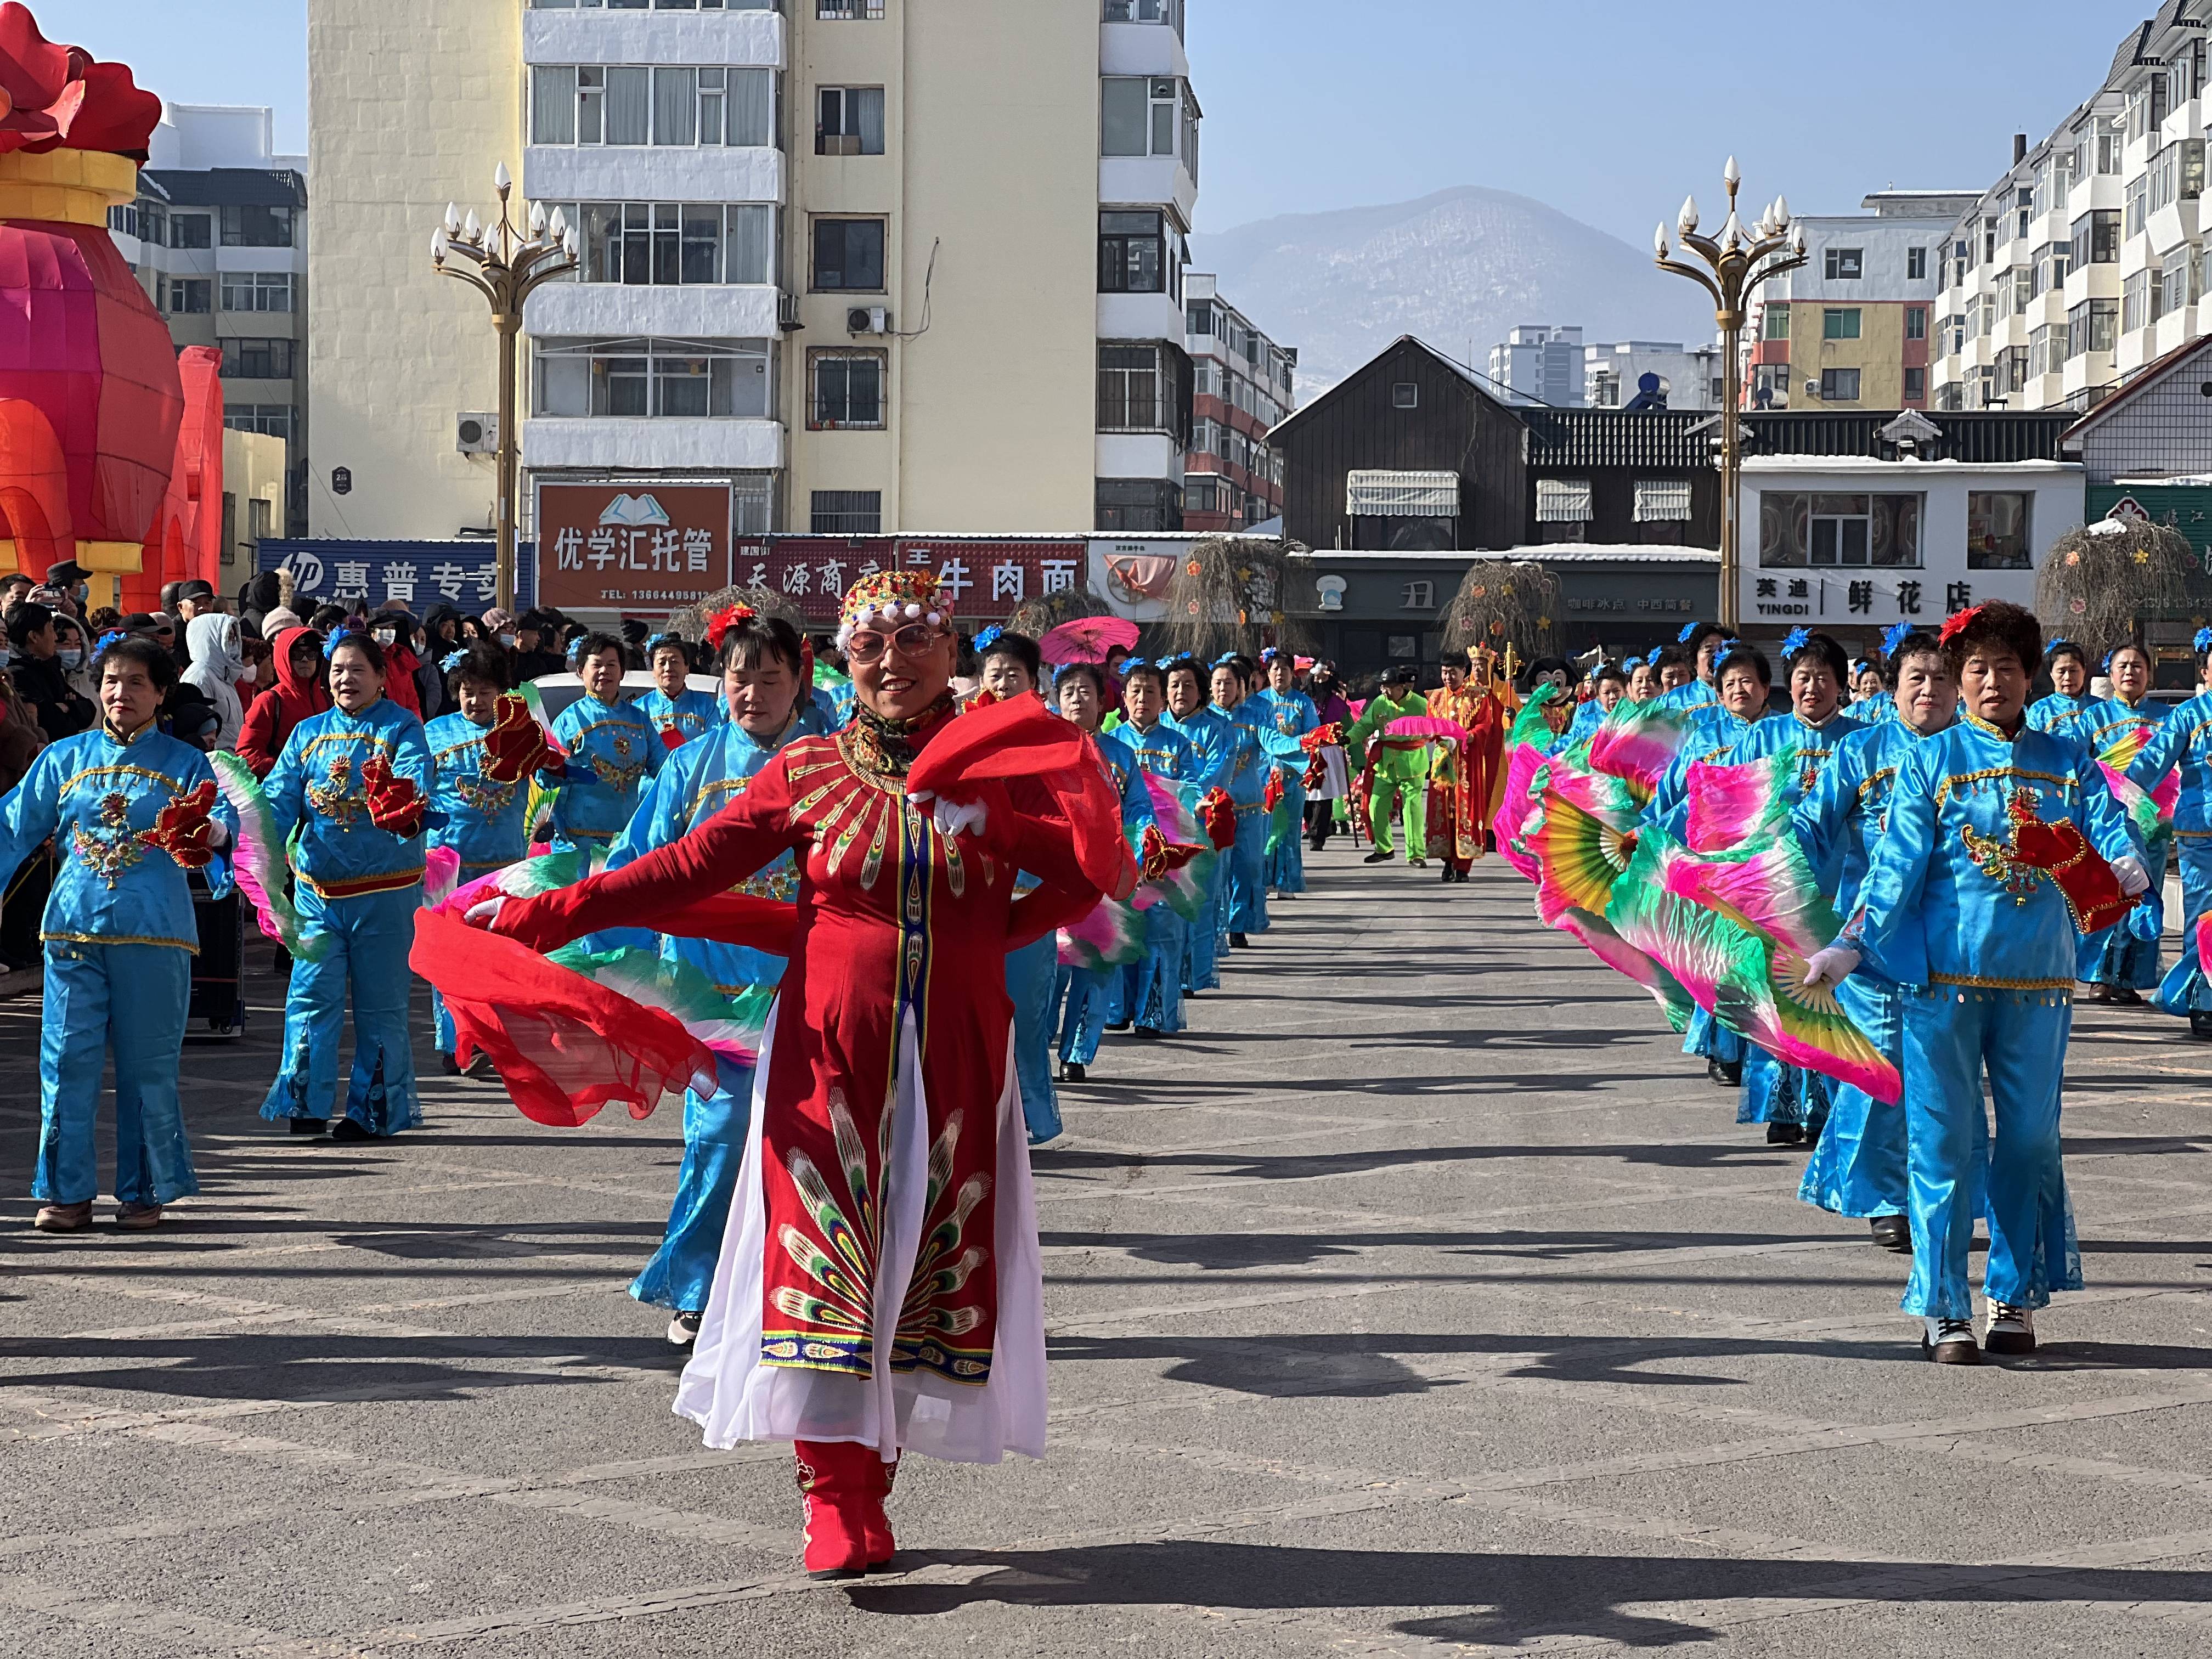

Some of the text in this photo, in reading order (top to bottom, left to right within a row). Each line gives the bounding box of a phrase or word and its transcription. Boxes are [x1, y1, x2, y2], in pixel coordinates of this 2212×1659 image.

[554, 527, 712, 572] 优学汇托管
[938, 557, 1077, 601] 牛肉面
[1756, 578, 1808, 597] 英迪
[601, 590, 626, 600] TEL:
[1567, 597, 1692, 611] 咖啡冰点 中西简餐
[1848, 580, 1971, 614] 鲜花店
[1757, 603, 1808, 616] YINGDI
